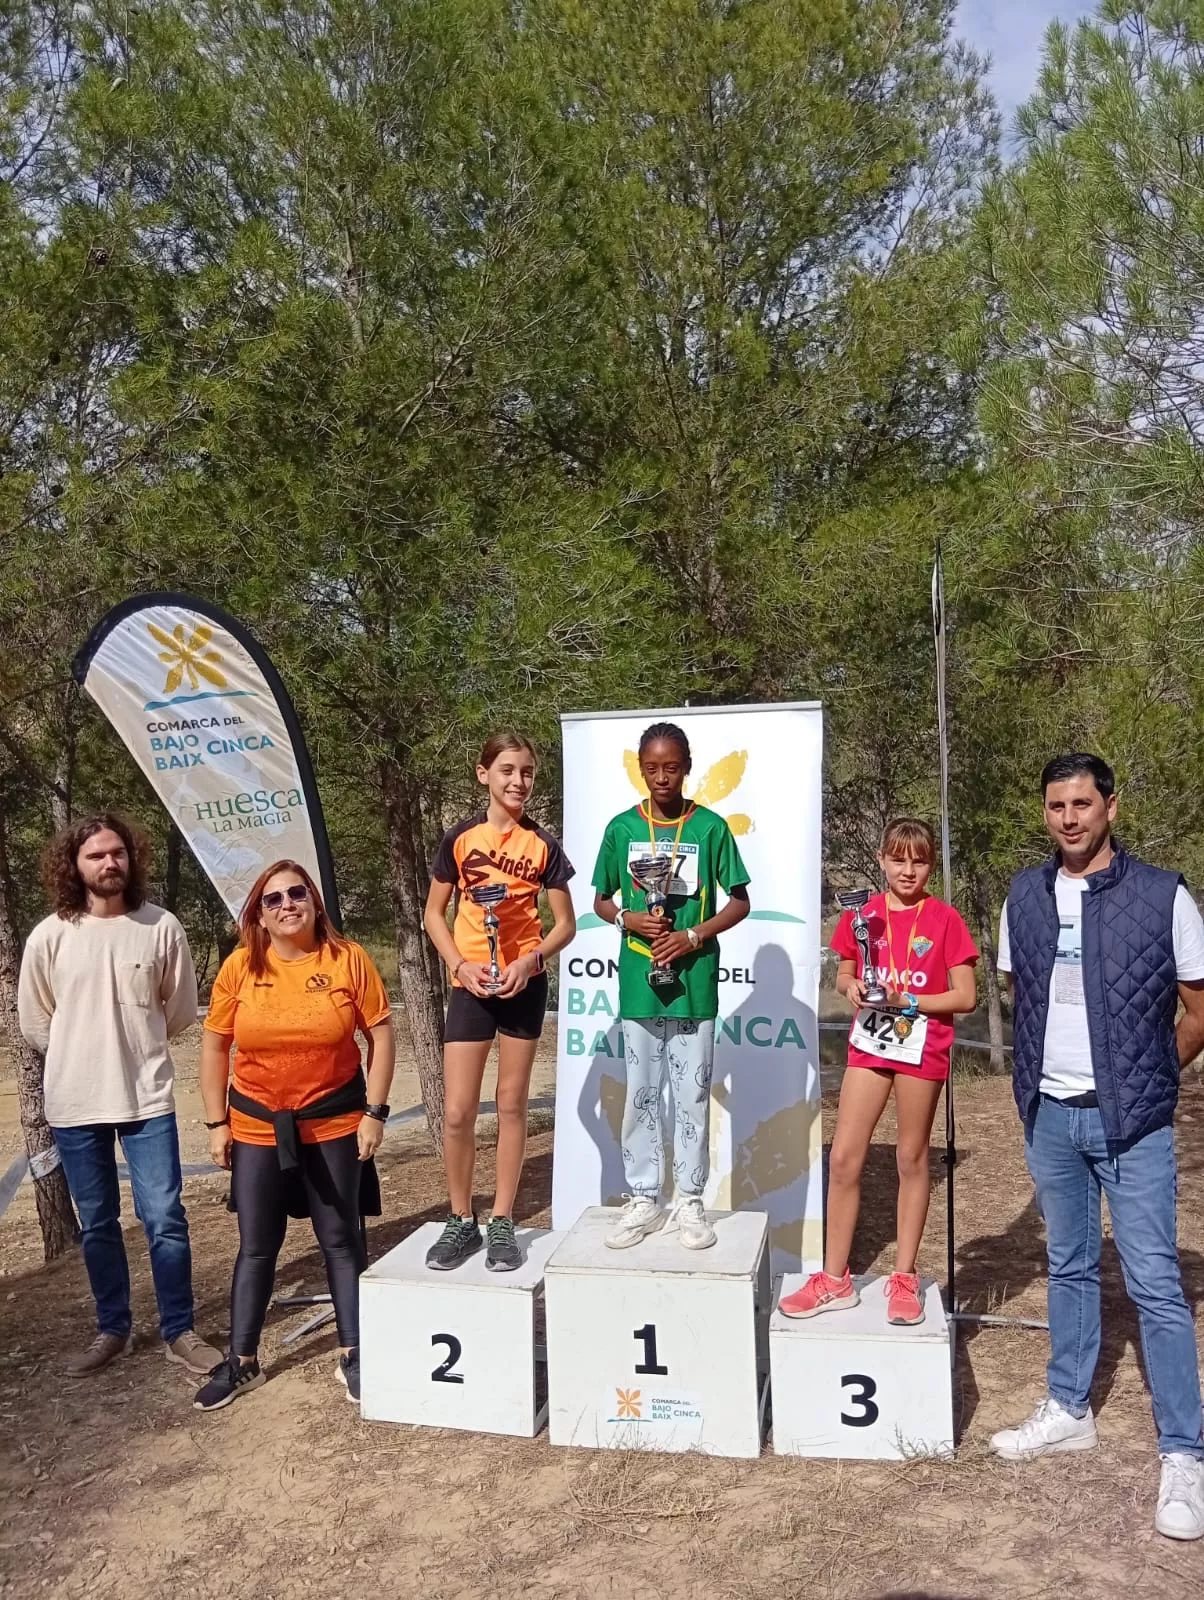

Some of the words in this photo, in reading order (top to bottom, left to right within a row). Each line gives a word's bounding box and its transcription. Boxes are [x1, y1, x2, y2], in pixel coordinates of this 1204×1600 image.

[146, 717, 220, 733] COMARCA
[223, 716, 245, 726] DEL
[150, 734, 199, 751] BAJO
[206, 735, 275, 755] CINCA
[155, 752, 205, 770] BAIX
[718, 967, 756, 984] DEL
[862, 965, 927, 988] NACO
[567, 988, 620, 1024] BA
[714, 1015, 807, 1050] NCA
[863, 1011, 904, 1045] 42
[566, 1028, 625, 1059] BAI
[431, 1333, 464, 1384] 2
[633, 1324, 668, 1376] 1
[652, 1405, 672, 1413] BAJO
[841, 1374, 879, 1427] 3
[673, 1410, 701, 1418] CINCA
